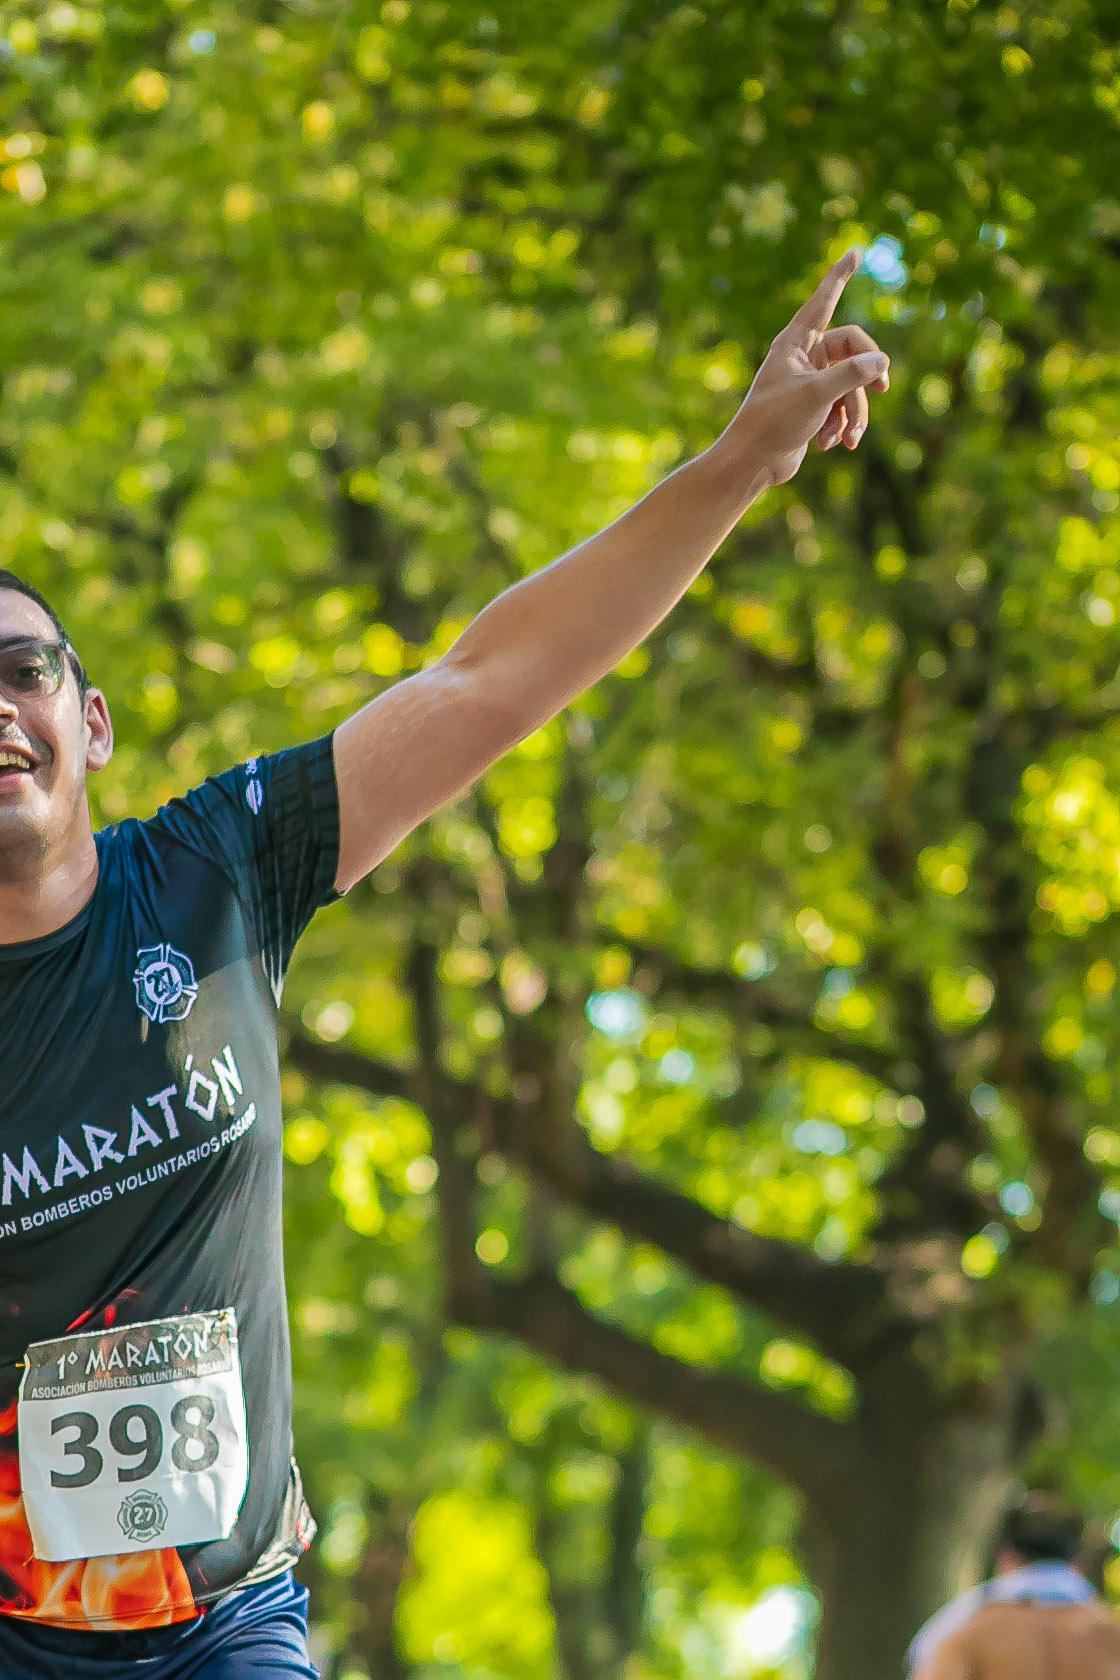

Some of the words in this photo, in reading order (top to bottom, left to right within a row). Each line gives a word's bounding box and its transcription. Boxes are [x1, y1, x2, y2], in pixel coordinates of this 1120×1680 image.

[2, 1043, 243, 1206] MARATÓN
[21, 1184, 113, 1231] BOMBEROS
[116, 1134, 220, 1195] VOLUNTARIOS
[31, 1381, 86, 1400] ASOCIACIÓN
[87, 1374, 138, 1391] BOMBEROS
[50, 1394, 220, 1489] 398
[133, 1506, 155, 1525] 27
